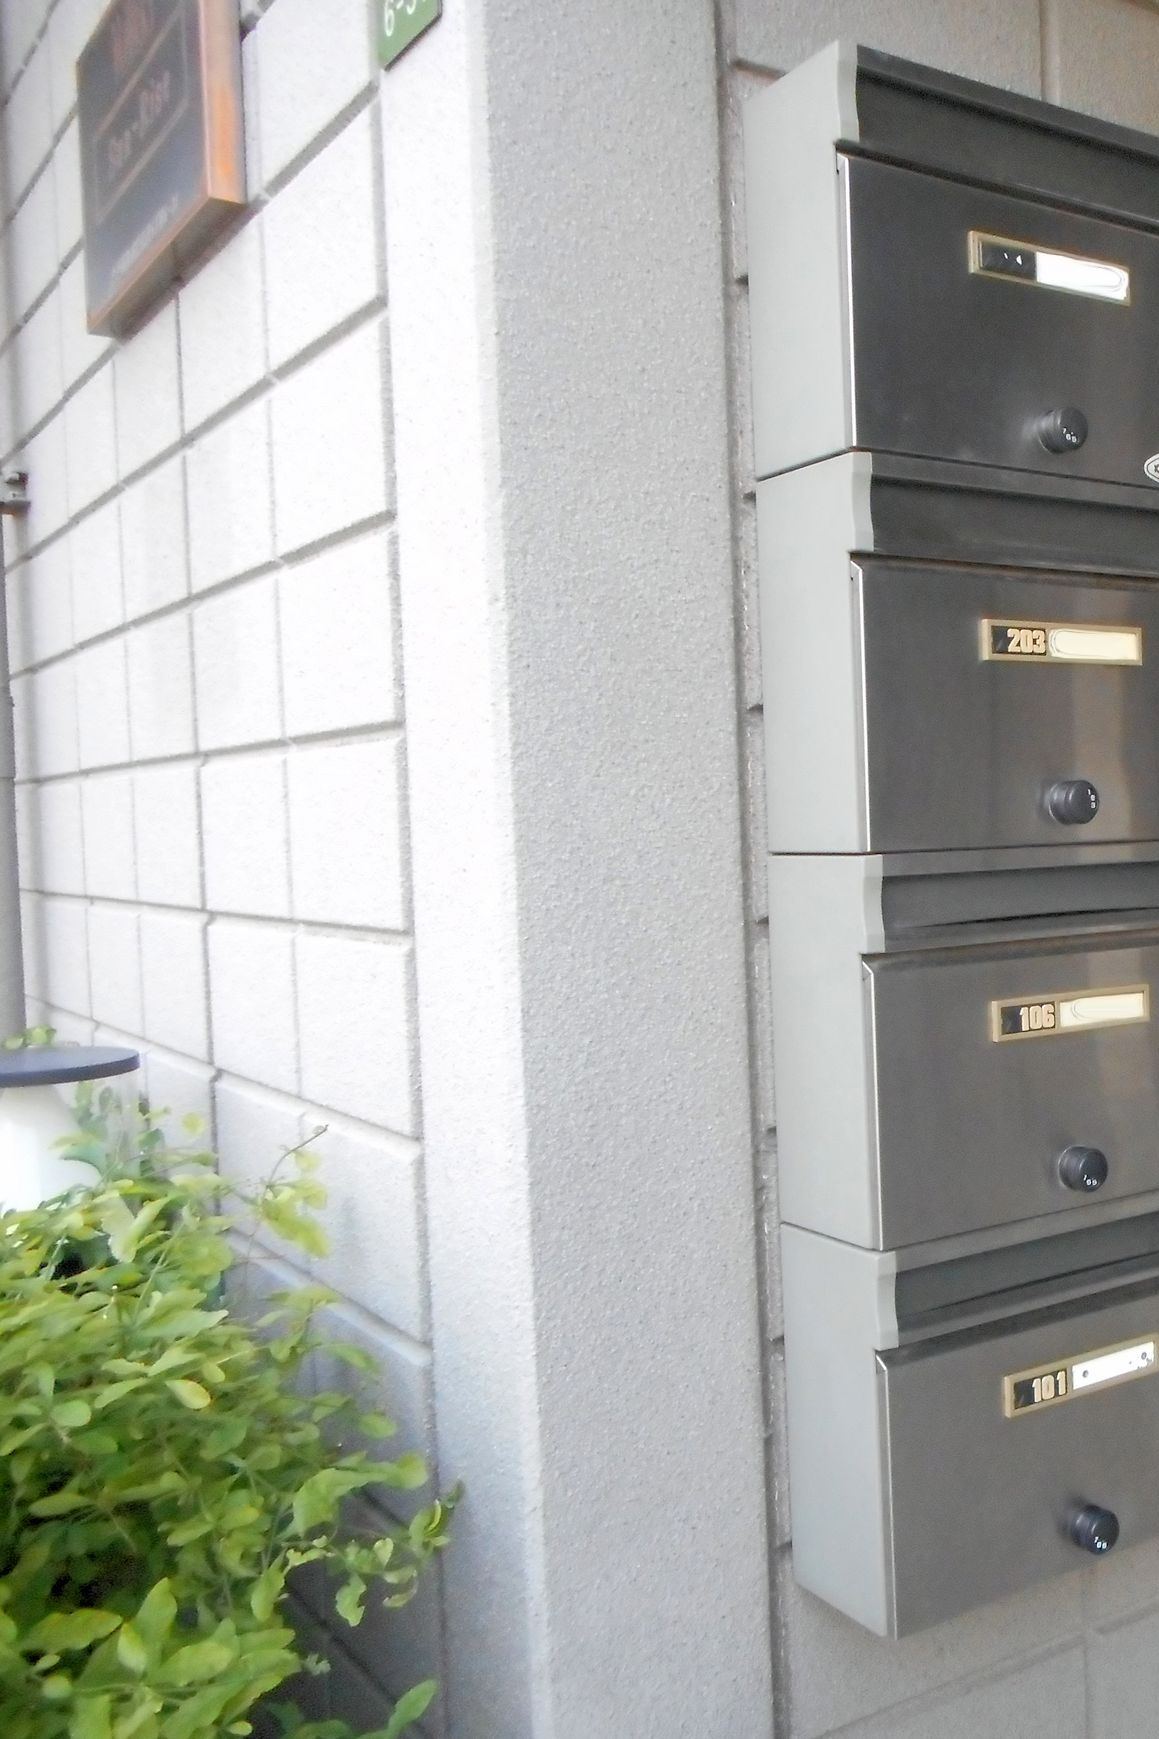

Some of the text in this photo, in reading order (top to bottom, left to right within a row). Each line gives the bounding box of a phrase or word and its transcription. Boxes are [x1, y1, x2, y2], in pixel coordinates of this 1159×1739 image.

[1007, 628, 1046, 654] 203
[1019, 1003, 1055, 1032] 106
[1032, 1370, 1067, 1403] 101
